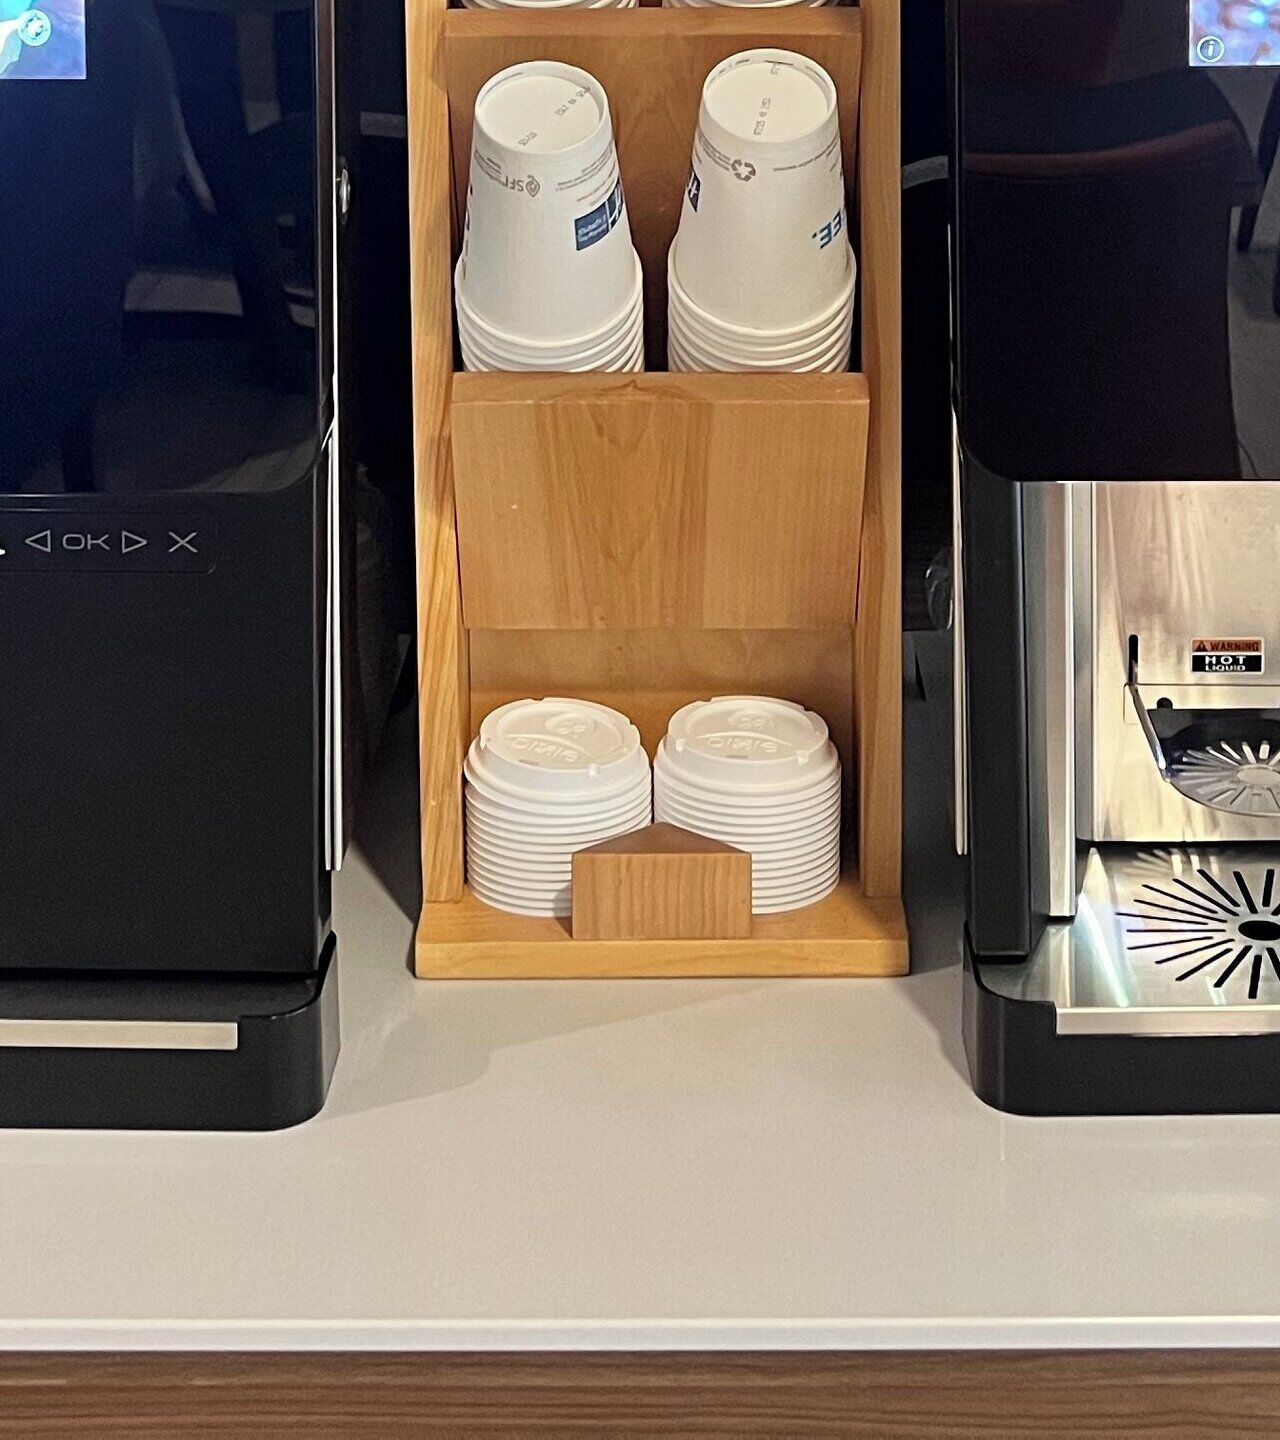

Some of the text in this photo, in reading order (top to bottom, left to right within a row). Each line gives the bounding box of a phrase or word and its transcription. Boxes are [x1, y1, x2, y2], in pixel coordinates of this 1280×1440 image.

[62, 533, 110, 550] OK
[1209, 641, 1259, 652] WARNING
[1204, 655, 1247, 665] HOT
[1205, 664, 1246, 672] LIQUID
